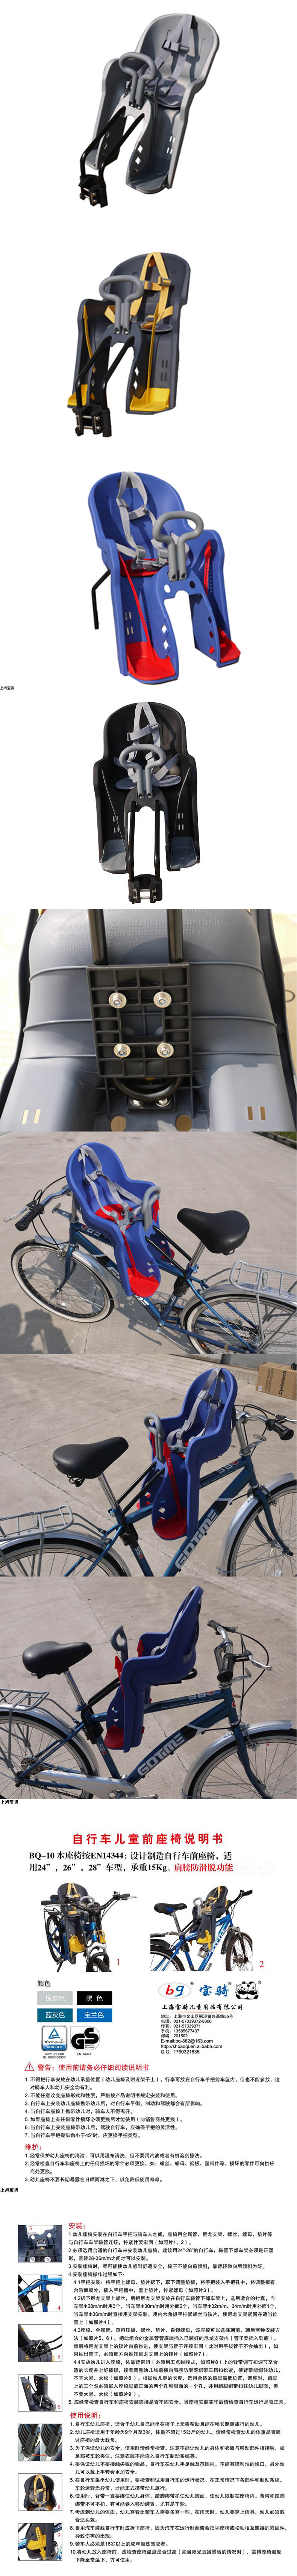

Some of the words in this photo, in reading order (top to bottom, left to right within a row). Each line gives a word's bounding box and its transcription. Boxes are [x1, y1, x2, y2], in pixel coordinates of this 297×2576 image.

[278, 1370, 287, 1395] Cyclotech
[73, 1833, 223, 1845] 自行车儿童前座椅说明书
